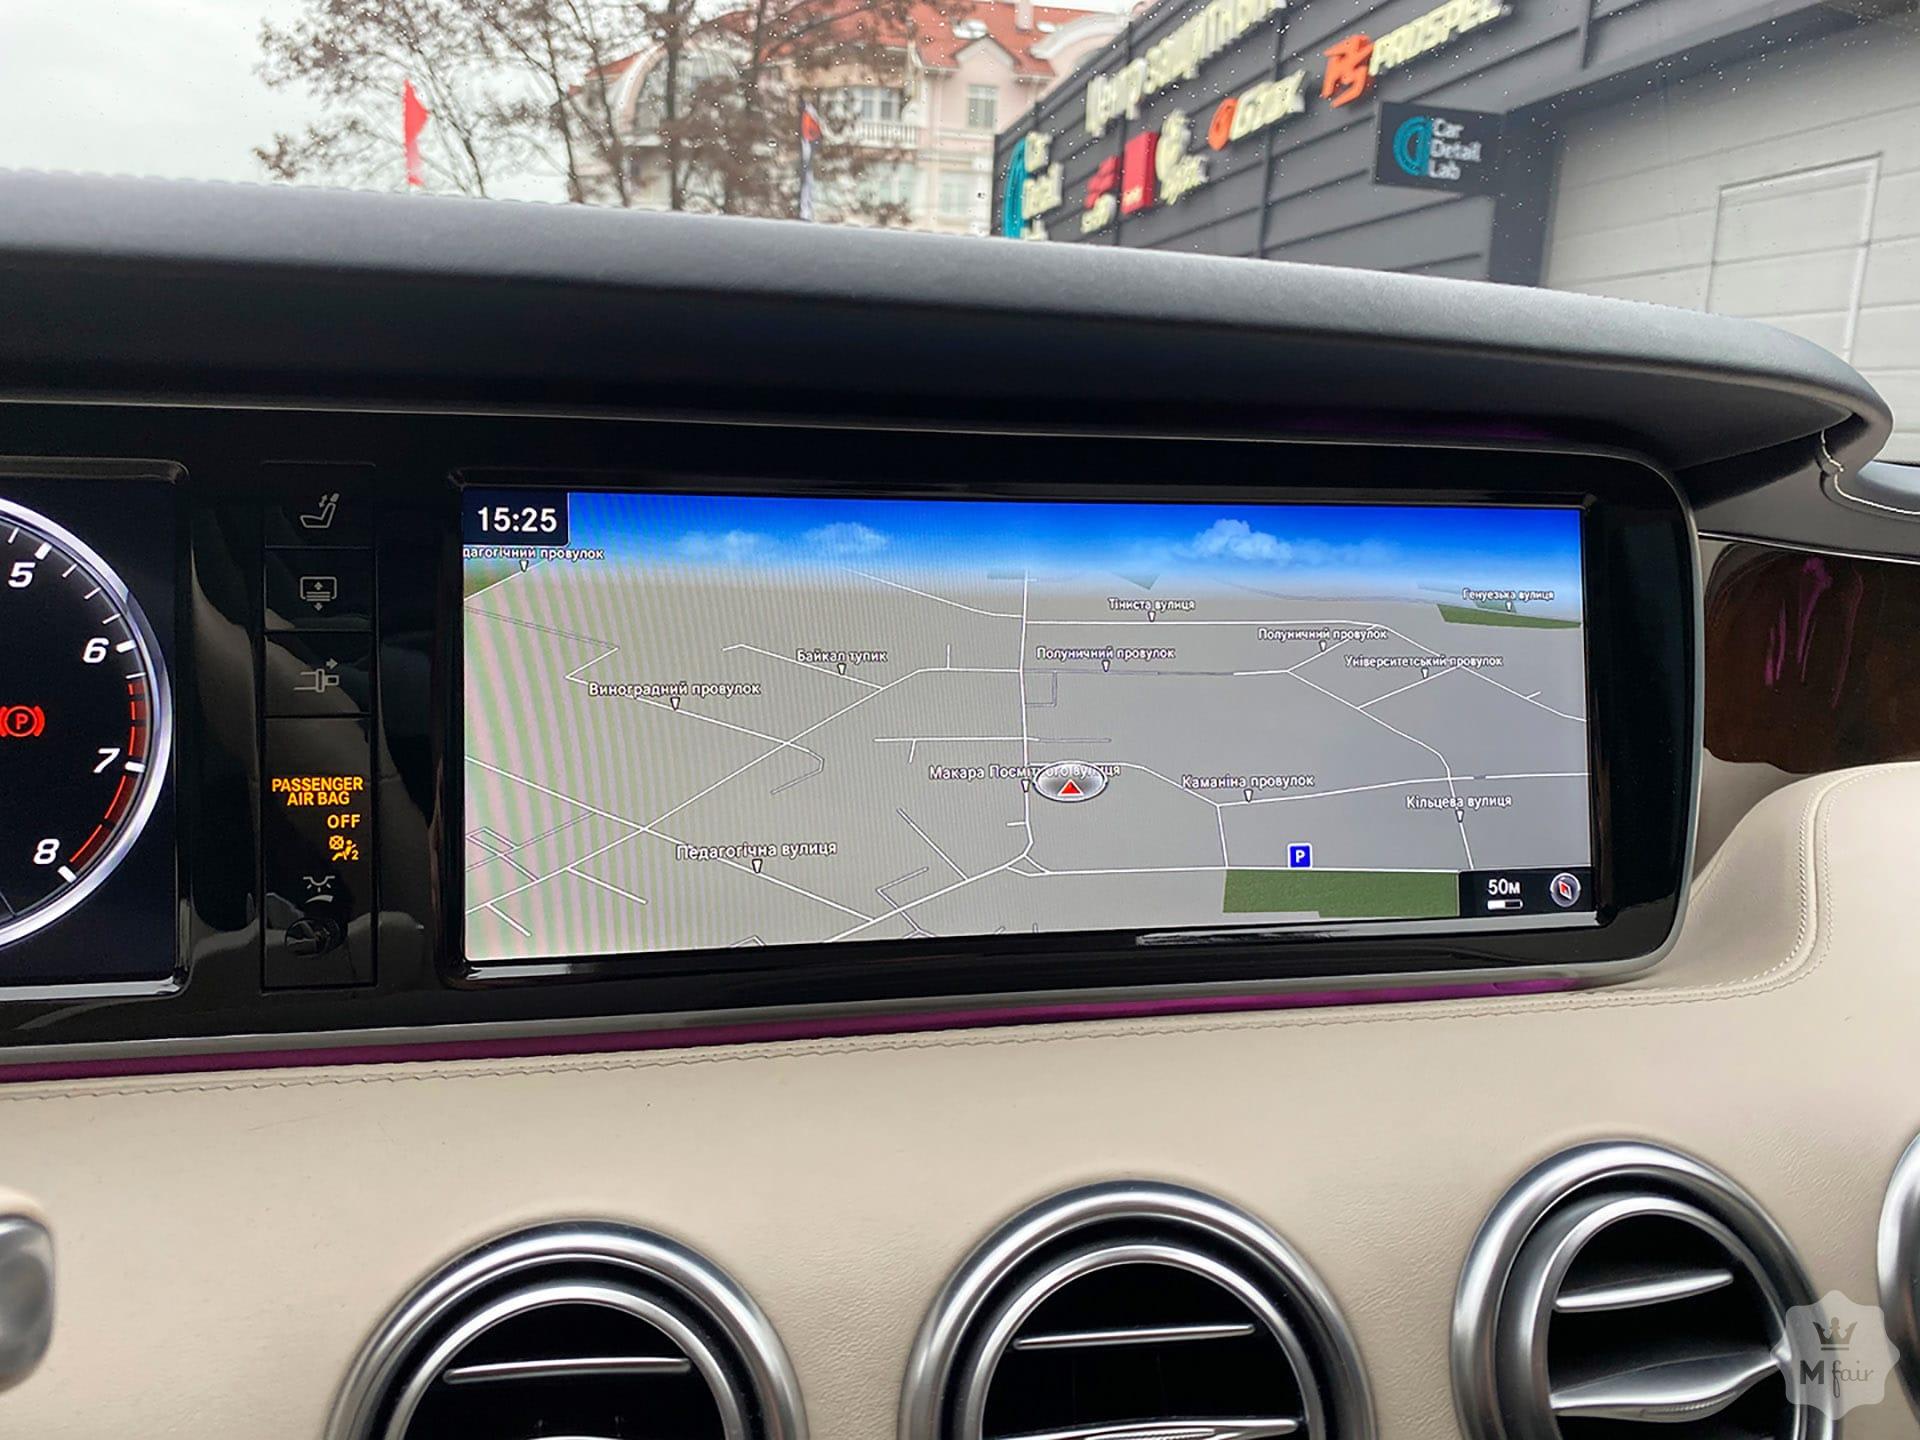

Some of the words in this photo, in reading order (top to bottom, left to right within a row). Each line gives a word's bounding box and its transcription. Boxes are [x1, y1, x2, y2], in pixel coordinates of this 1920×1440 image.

[478, 507, 558, 533] 15:25
[541, 548, 605, 562] провулок
[8, 562, 35, 588] 5
[1108, 597, 1150, 613] Тіниста
[1154, 598, 1195, 613] вулиця
[1519, 590, 1555, 603] вулиця
[1258, 627, 1330, 642] Полуничний
[1333, 629, 1388, 642] провулок
[83, 637, 109, 663] 6
[797, 648, 846, 663] Байкал
[850, 650, 888, 664] тупик
[1036, 645, 1114, 661] Полуничний
[1117, 647, 1176, 662] провулок
[1449, 654, 1503, 668] провулок
[588, 678, 689, 698] Виноградний
[692, 681, 761, 698] провулок
[93, 747, 120, 773] 7
[929, 764, 985, 781] Макара
[1182, 772, 1248, 790] Каманіна
[1250, 772, 1314, 790] провулок
[271, 776, 363, 792] PASSENGER
[287, 791, 314, 806] AIR
[317, 790, 350, 806] BAG
[1406, 795, 1465, 811] Кільцева
[1468, 793, 1512, 809] вулиця
[327, 813, 360, 829] OFF
[33, 838, 60, 865] 8
[676, 842, 777, 861] Педагогічна
[781, 841, 838, 859] вулиця
[1487, 878, 1521, 896] 50м
